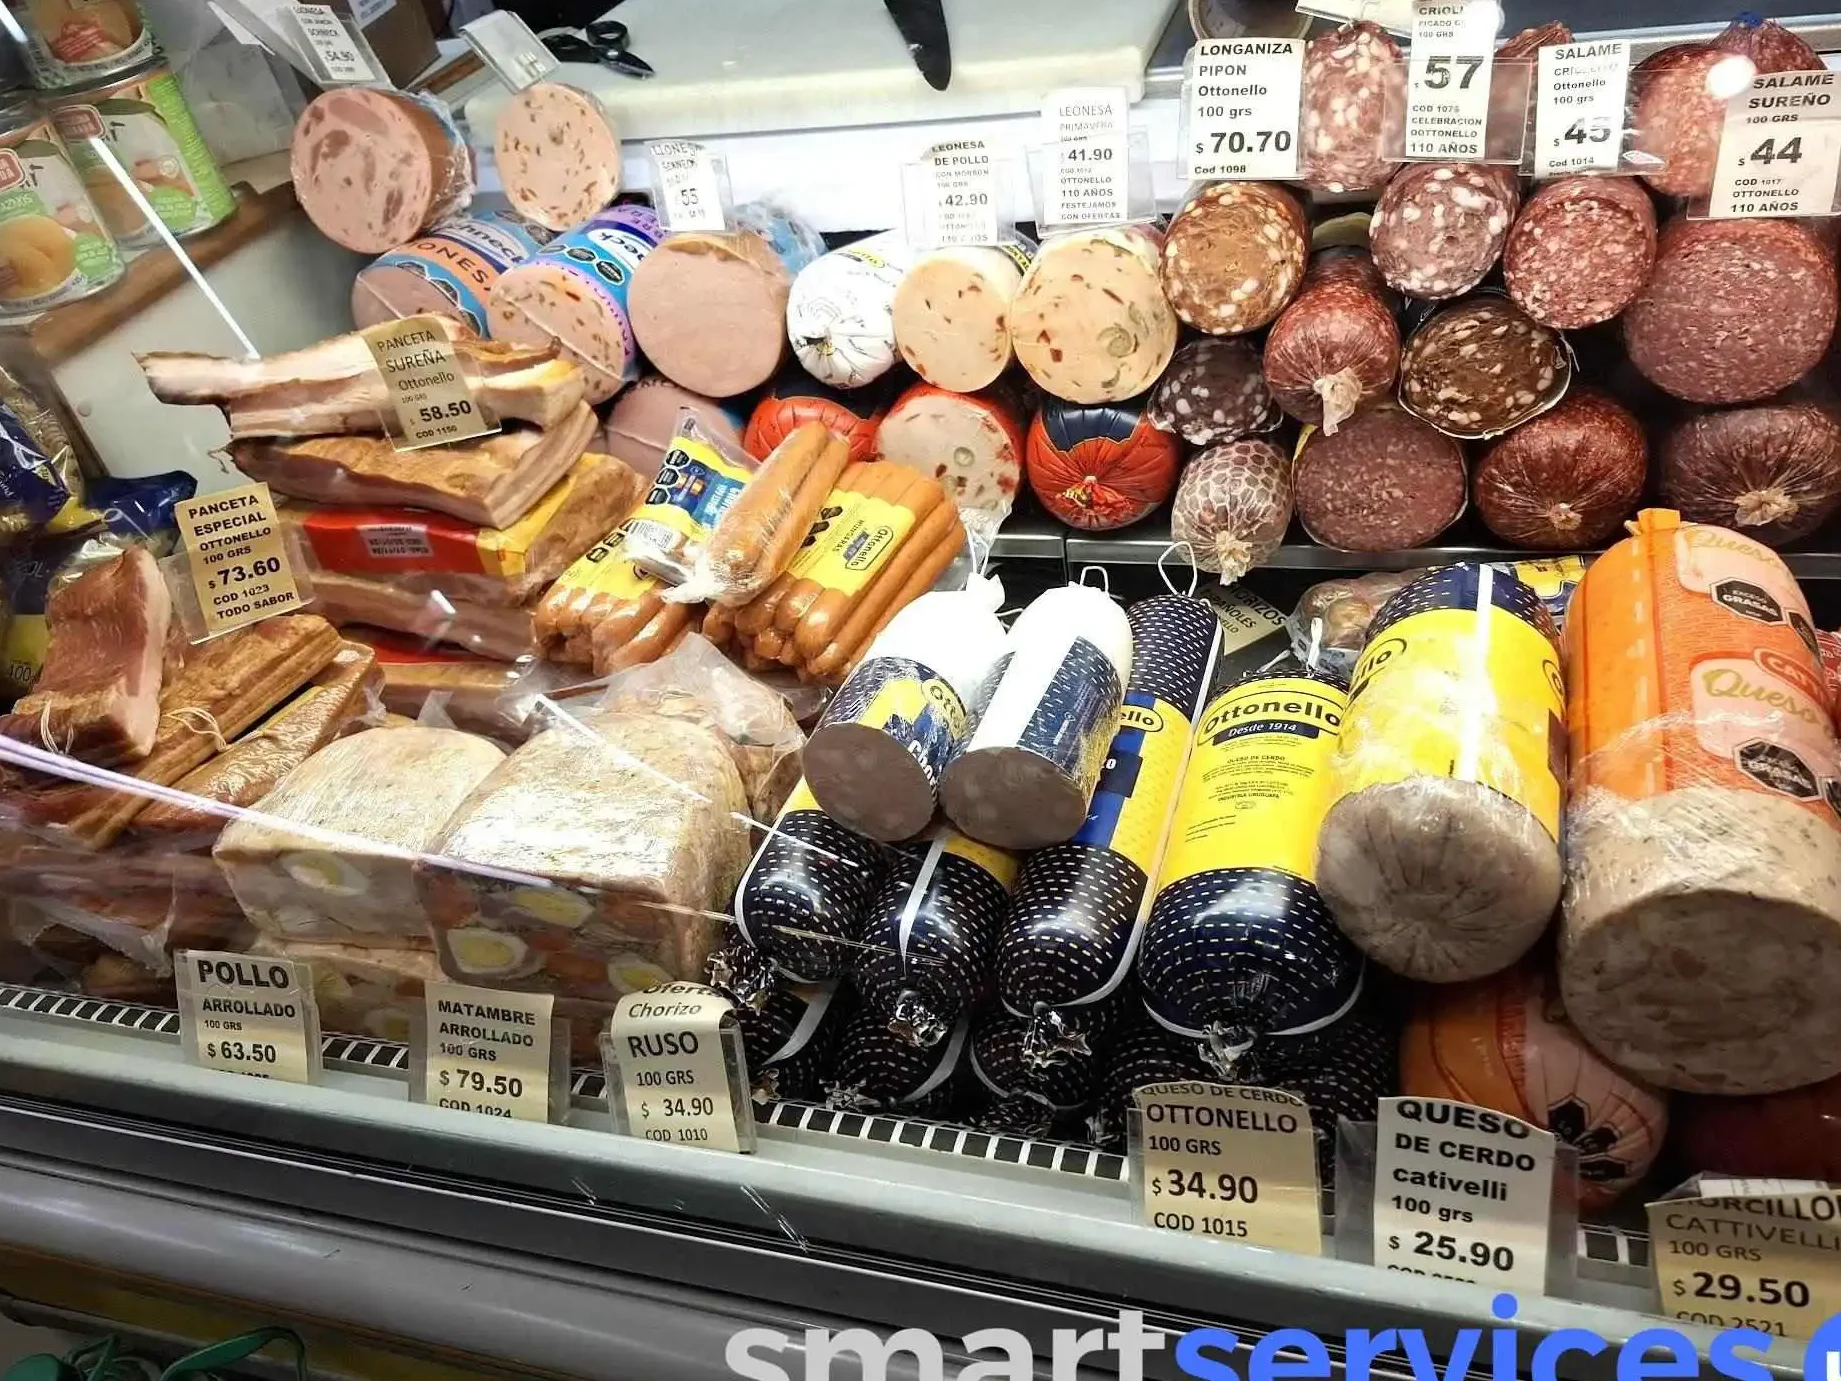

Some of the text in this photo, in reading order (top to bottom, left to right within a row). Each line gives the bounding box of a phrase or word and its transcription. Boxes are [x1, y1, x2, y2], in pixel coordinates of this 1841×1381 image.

[1200, 44, 1293, 56] LONGANIZA
[1555, 43, 1622, 60] SALAME
[1199, 65, 1247, 77] PIPON
[1424, 55, 1484, 89] 57
[1198, 85, 1267, 96] Ottonello
[1554, 78, 1606, 91] Ottonello
[1753, 73, 1835, 90] SALAME
[1060, 104, 1113, 117] LEONESA
[1554, 94, 1594, 107] 100 grs
[1748, 92, 1831, 109] SUREÑO
[1198, 106, 1252, 119] 100 grs
[1411, 117, 1482, 126] CELEBRACION
[1746, 113, 1799, 125] 100 GRS
[932, 140, 985, 153] LEONESA
[1196, 130, 1291, 154] $ 70.70
[1410, 141, 1478, 154] 110 AÑOS
[1553, 138, 1559, 147] $
[1738, 136, 1802, 166] $ 44
[934, 156, 989, 166] DE POLLO
[1068, 148, 1113, 161] 41.90
[1548, 159, 1567, 168] Cod
[1194, 164, 1246, 175] Cod 1098
[1734, 178, 1757, 186] COD
[945, 193, 988, 206] 42.90
[1062, 188, 1113, 197] 110 AÑOS
[1732, 187, 1799, 198] OTTONELLO
[1061, 201, 1116, 209] FESTEJAMOS
[1729, 200, 1799, 213] 110 AÑOS
[377, 330, 436, 352] PANCETA
[386, 349, 447, 373] SUREÑA
[398, 372, 455, 391] Ottonello
[420, 400, 472, 422] 58.50
[415, 429, 434, 439] COD
[189, 495, 259, 519] PANCETA
[194, 511, 266, 536] ESPECIAL
[200, 527, 272, 551] OTTONELLO
[203, 545, 253, 565] 100 GRS
[208, 557, 281, 589] $ 73.60
[213, 584, 270, 606] COD 1023
[217, 592, 295, 619] TODO SABOR
[1204, 701, 1341, 735] Ottonello
[1228, 722, 1297, 737] Desde 1914
[197, 959, 290, 990] POLLO
[202, 998, 296, 1019] ARROLLADO
[438, 1000, 536, 1026] MATAMBRE
[628, 1002, 702, 1018] Chorizo
[204, 1020, 243, 1031] 100 GRS
[439, 1022, 535, 1048] ARROLLADO
[207, 1040, 277, 1064] $ 63.50
[439, 1042, 498, 1062] 100 GRS
[627, 1031, 699, 1058] RUSO
[439, 1068, 523, 1099] $ 79.50
[636, 1069, 695, 1086] 100 GRS
[1141, 1083, 1204, 1095] QUESO
[1210, 1085, 1235, 1098] DE
[439, 1098, 512, 1120] COD 1024
[641, 1097, 714, 1119] $ 34.90
[1146, 1103, 1298, 1134] OTTONELLO
[1397, 1100, 1530, 1139] QUESO
[645, 1128, 708, 1142] COD 1010
[1148, 1135, 1222, 1156] 100 GRS
[1395, 1133, 1536, 1172] DE CERDO
[1152, 1169, 1258, 1204] $ 34.90
[1393, 1167, 1507, 1201] cativelli
[1391, 1195, 1474, 1223] 100 grs
[1154, 1211, 1248, 1237] COD 1015
[1666, 1213, 1841, 1250] CATTIVELLI
[1388, 1230, 1514, 1272] $ 25.90
[1669, 1240, 1762, 1262] 100 GRS
[1673, 1271, 1810, 1308] $ 29.50
